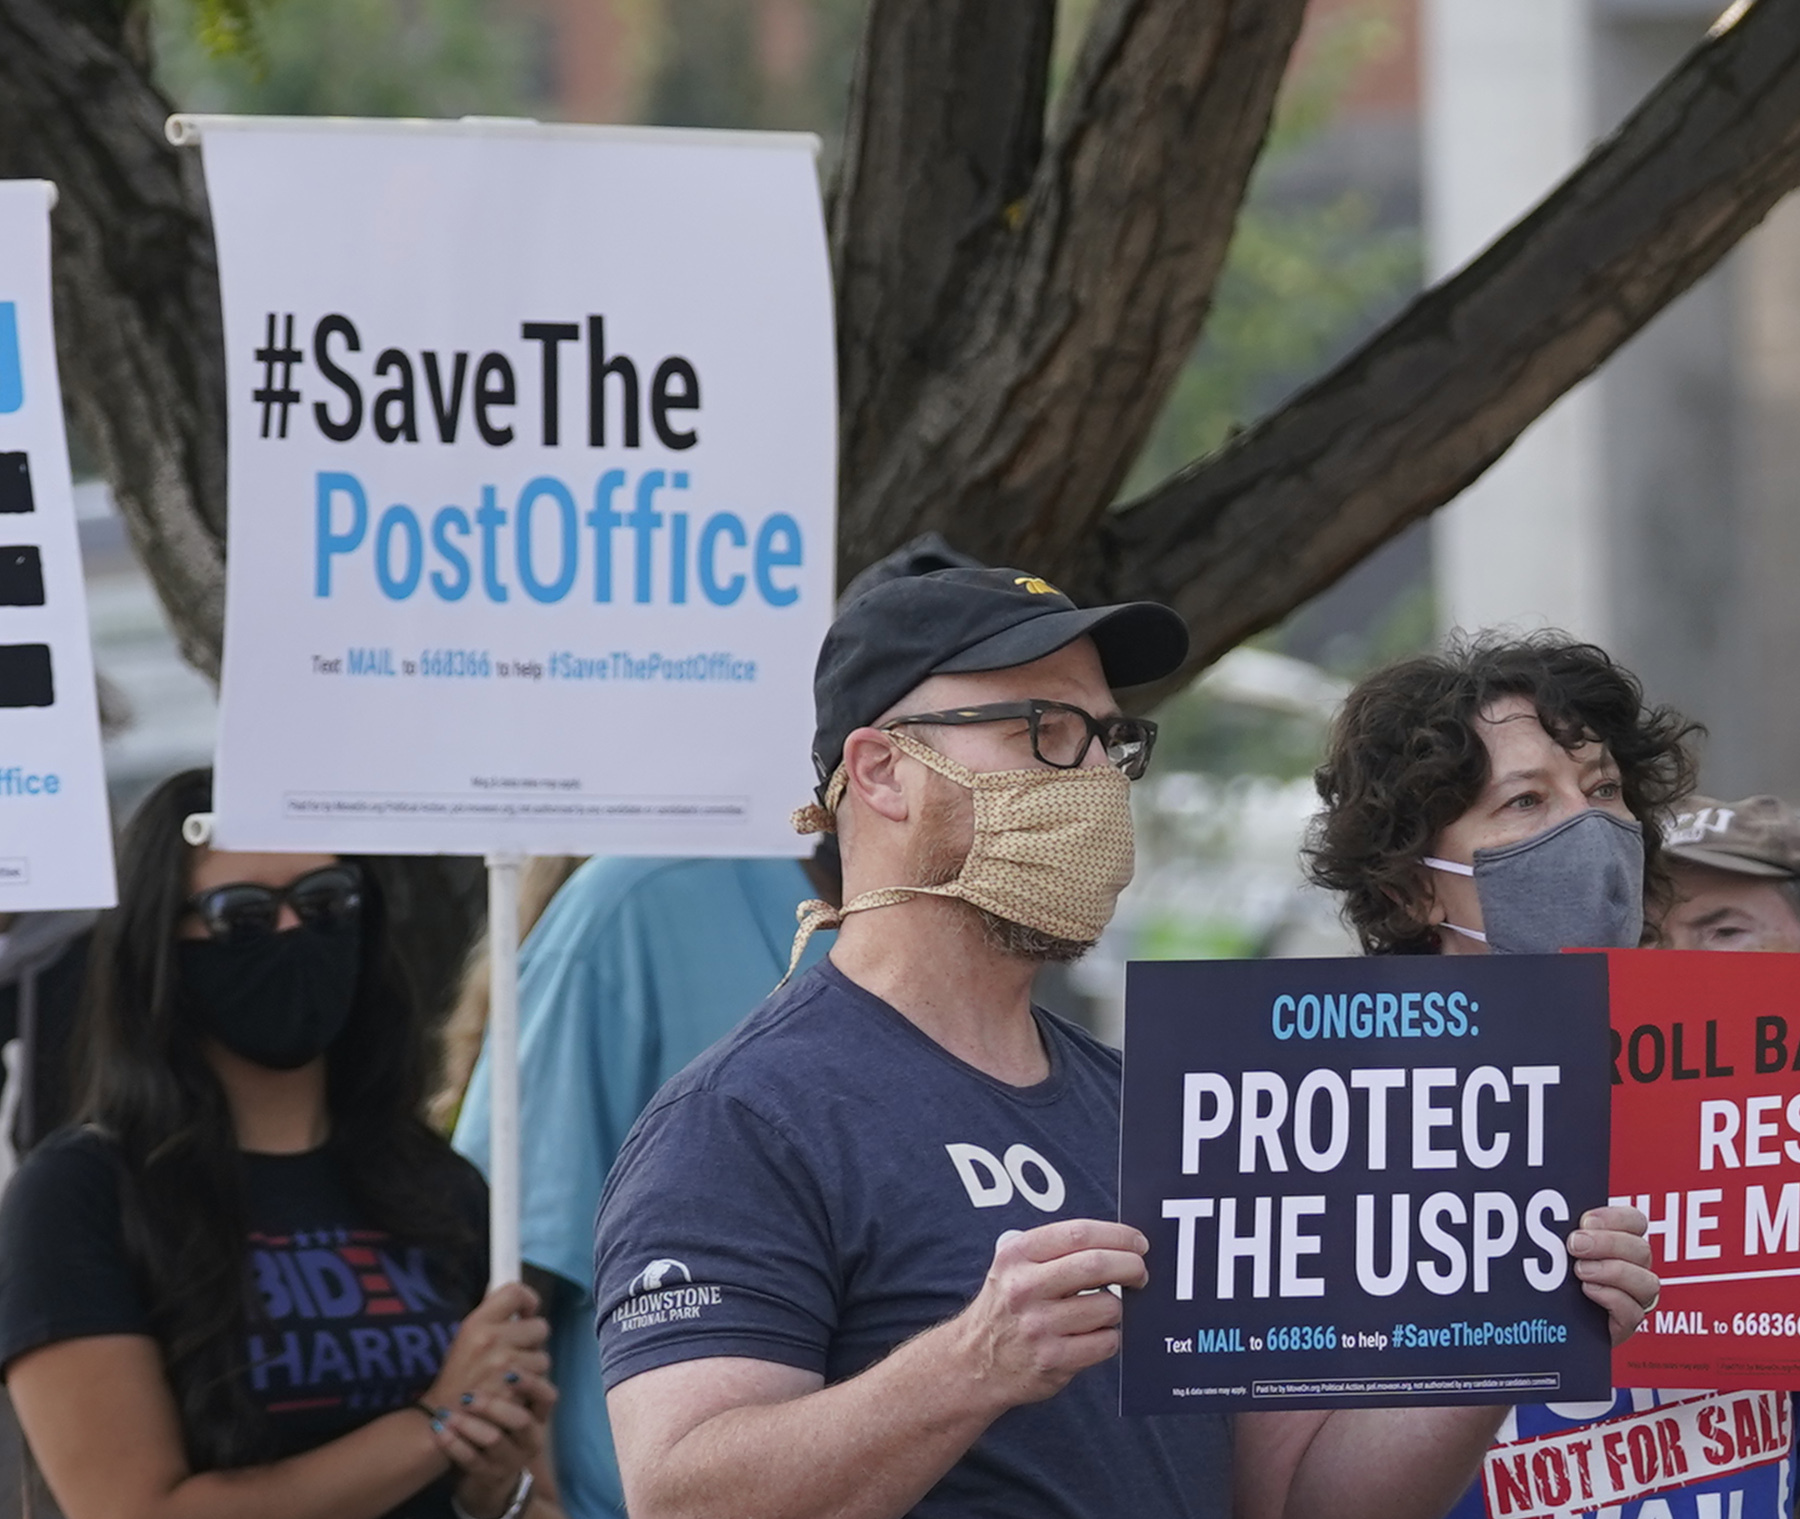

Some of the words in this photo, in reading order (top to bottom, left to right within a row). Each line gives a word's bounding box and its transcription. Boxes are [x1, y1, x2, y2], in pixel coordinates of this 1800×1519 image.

[254, 312, 701, 450] #SaveThe
[313, 469, 805, 608] PostOffice
[312, 655, 342, 674] Text
[347, 648, 396, 676] MAIL
[402, 660, 417, 675] to
[420, 650, 490, 677] 668366
[496, 661, 508, 677] to
[549, 652, 757, 682] #SaveThePostOffice
[1272, 992, 1480, 1040] CONGRESS:
[1182, 1066, 1560, 1174] PROTECT
[944, 1142, 1066, 1213] DO
[1162, 1195, 1325, 1300] THE
[1356, 1188, 1570, 1296] USPS
[621, 1310, 667, 1333] NATIONAL
[669, 1306, 701, 1322] PARK
[1165, 1337, 1192, 1353] Text
[1198, 1328, 1245, 1353] MAIL
[1250, 1337, 1263, 1350] to
[1267, 1325, 1337, 1350] 668366
[1342, 1333, 1355, 1348] to
[1358, 1331, 1388, 1351] help
[1392, 1319, 1568, 1348] #SaveThePostOffice
[1655, 1311, 1709, 1335] MAIL
[1713, 1320, 1728, 1334] to
[250, 1322, 464, 1390] HARRI
[1492, 1438, 1592, 1514] NOT
[1603, 1418, 1688, 1491] FOR
[1696, 1393, 1789, 1465] SALE
